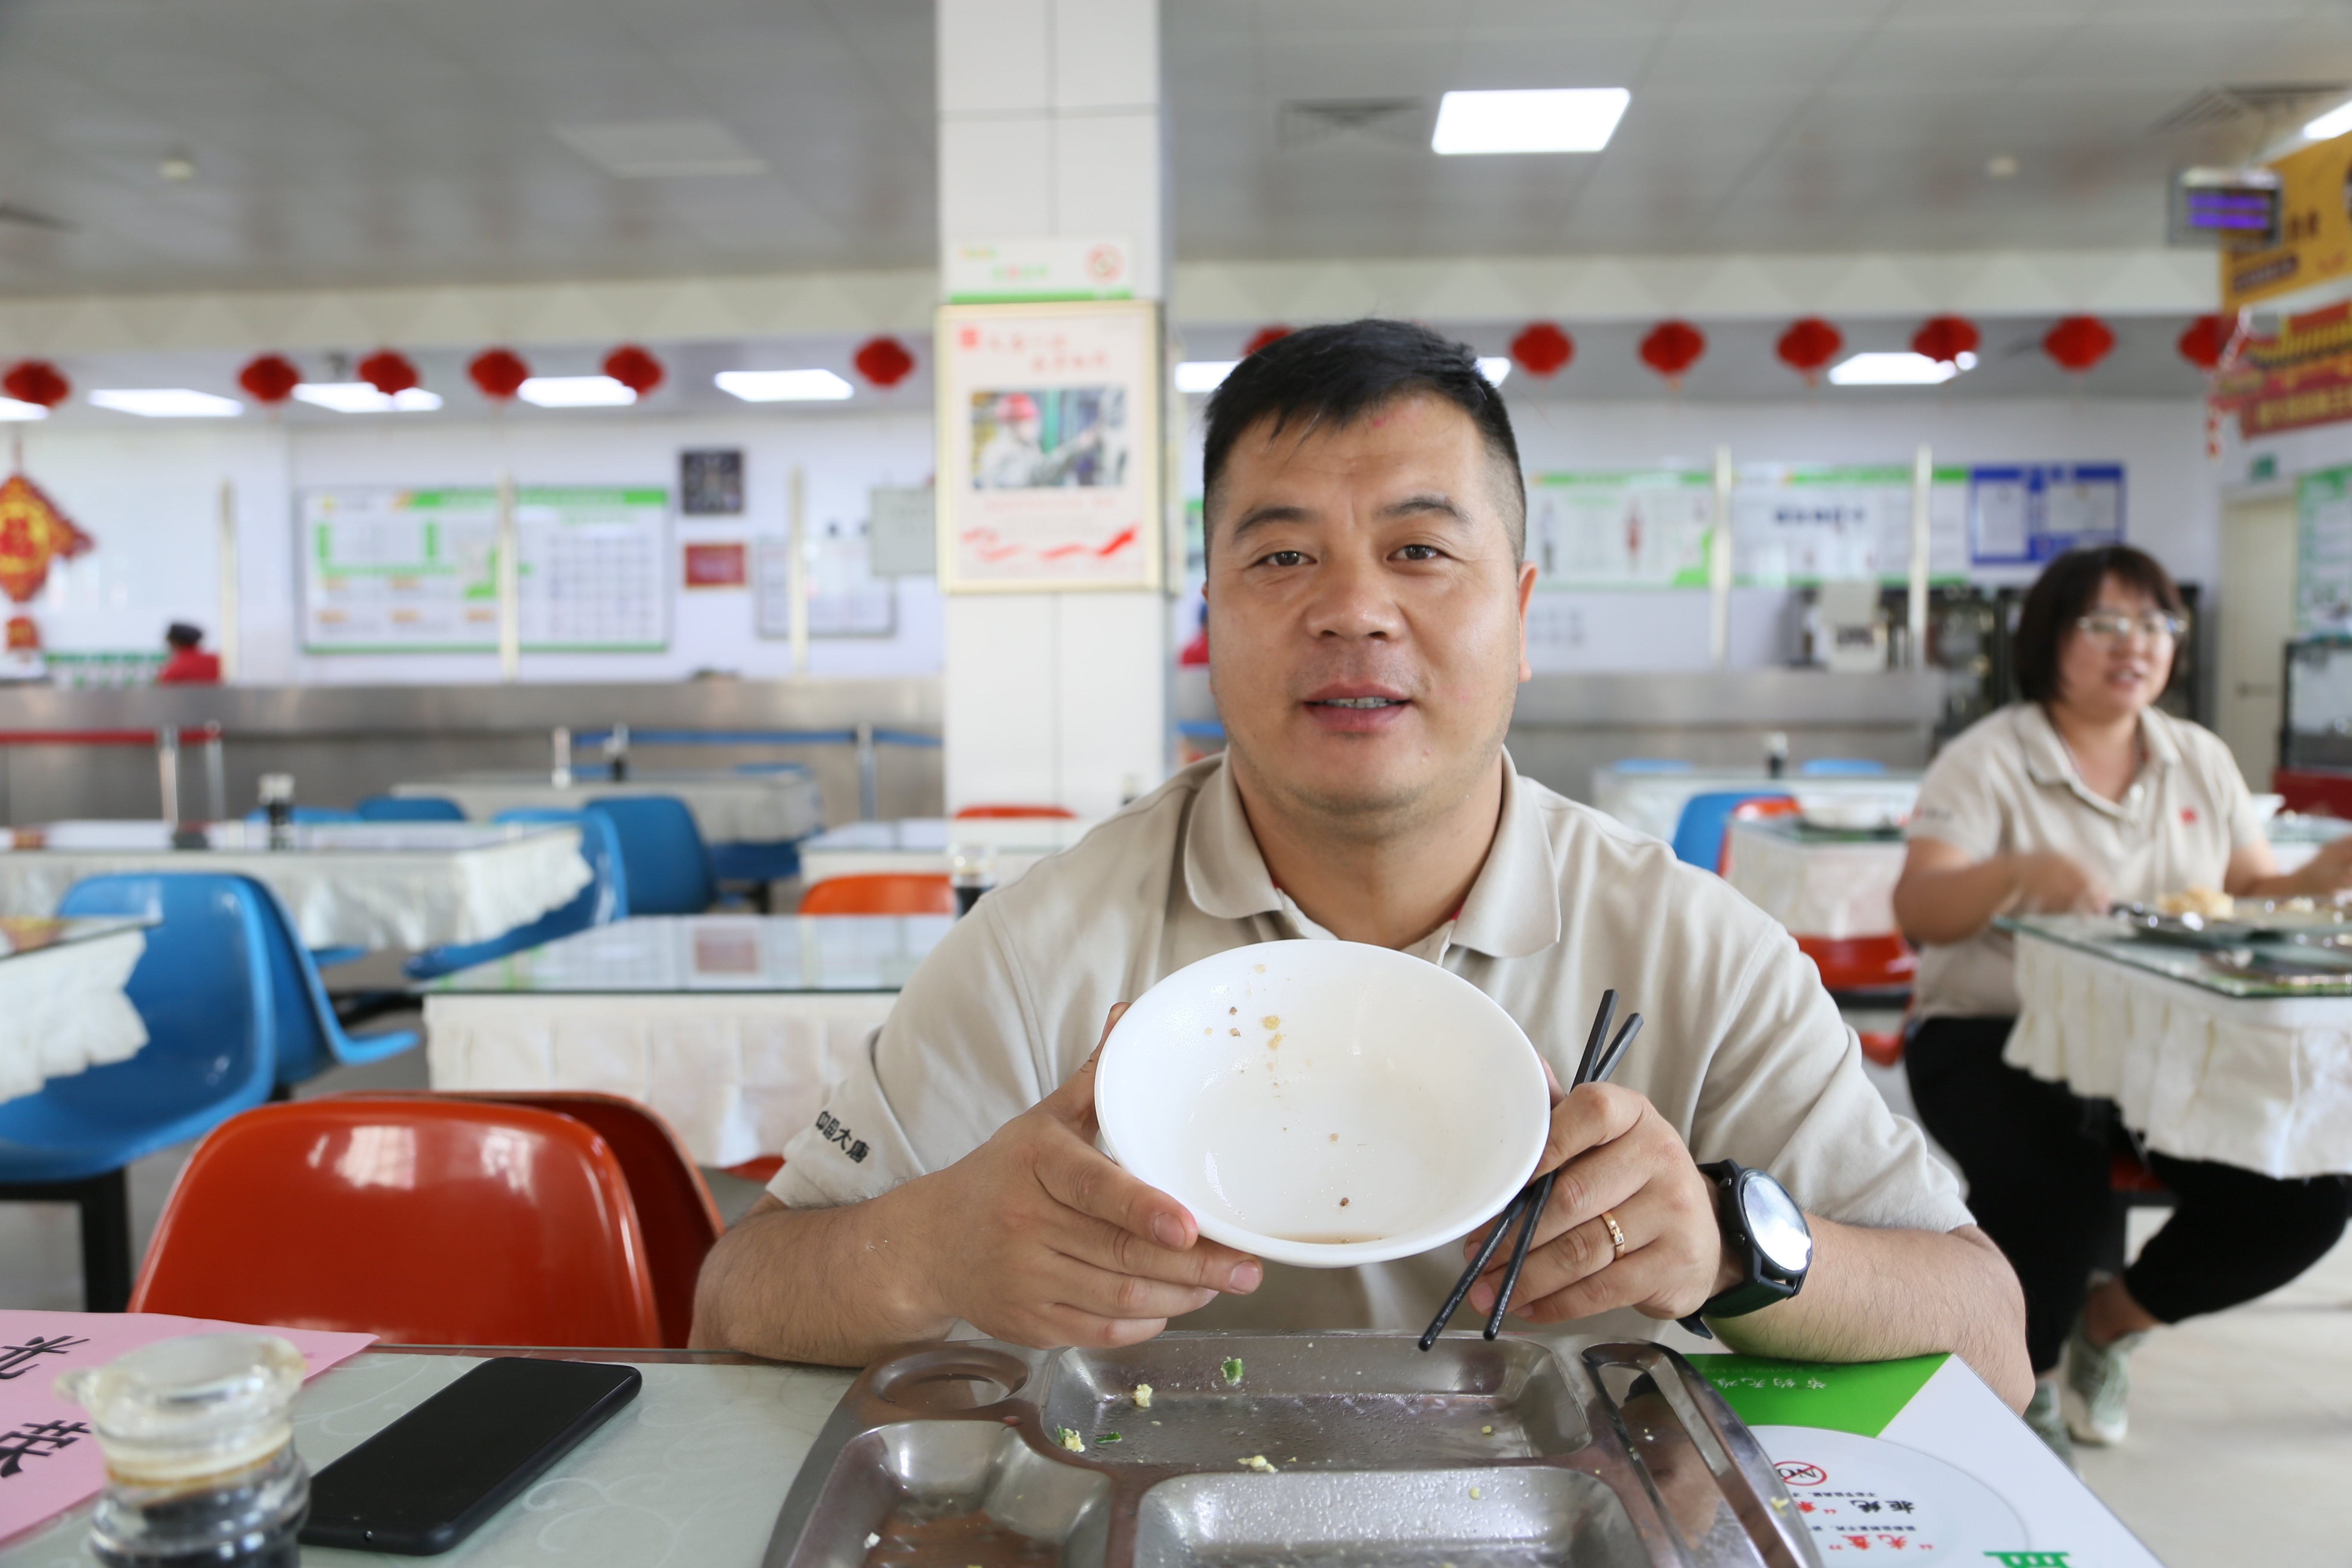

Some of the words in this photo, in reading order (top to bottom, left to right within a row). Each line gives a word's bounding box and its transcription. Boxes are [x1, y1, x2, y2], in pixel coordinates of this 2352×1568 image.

[816, 1111, 870, 1163] 中国大唐
[1778, 1468, 1819, 1479] NO
